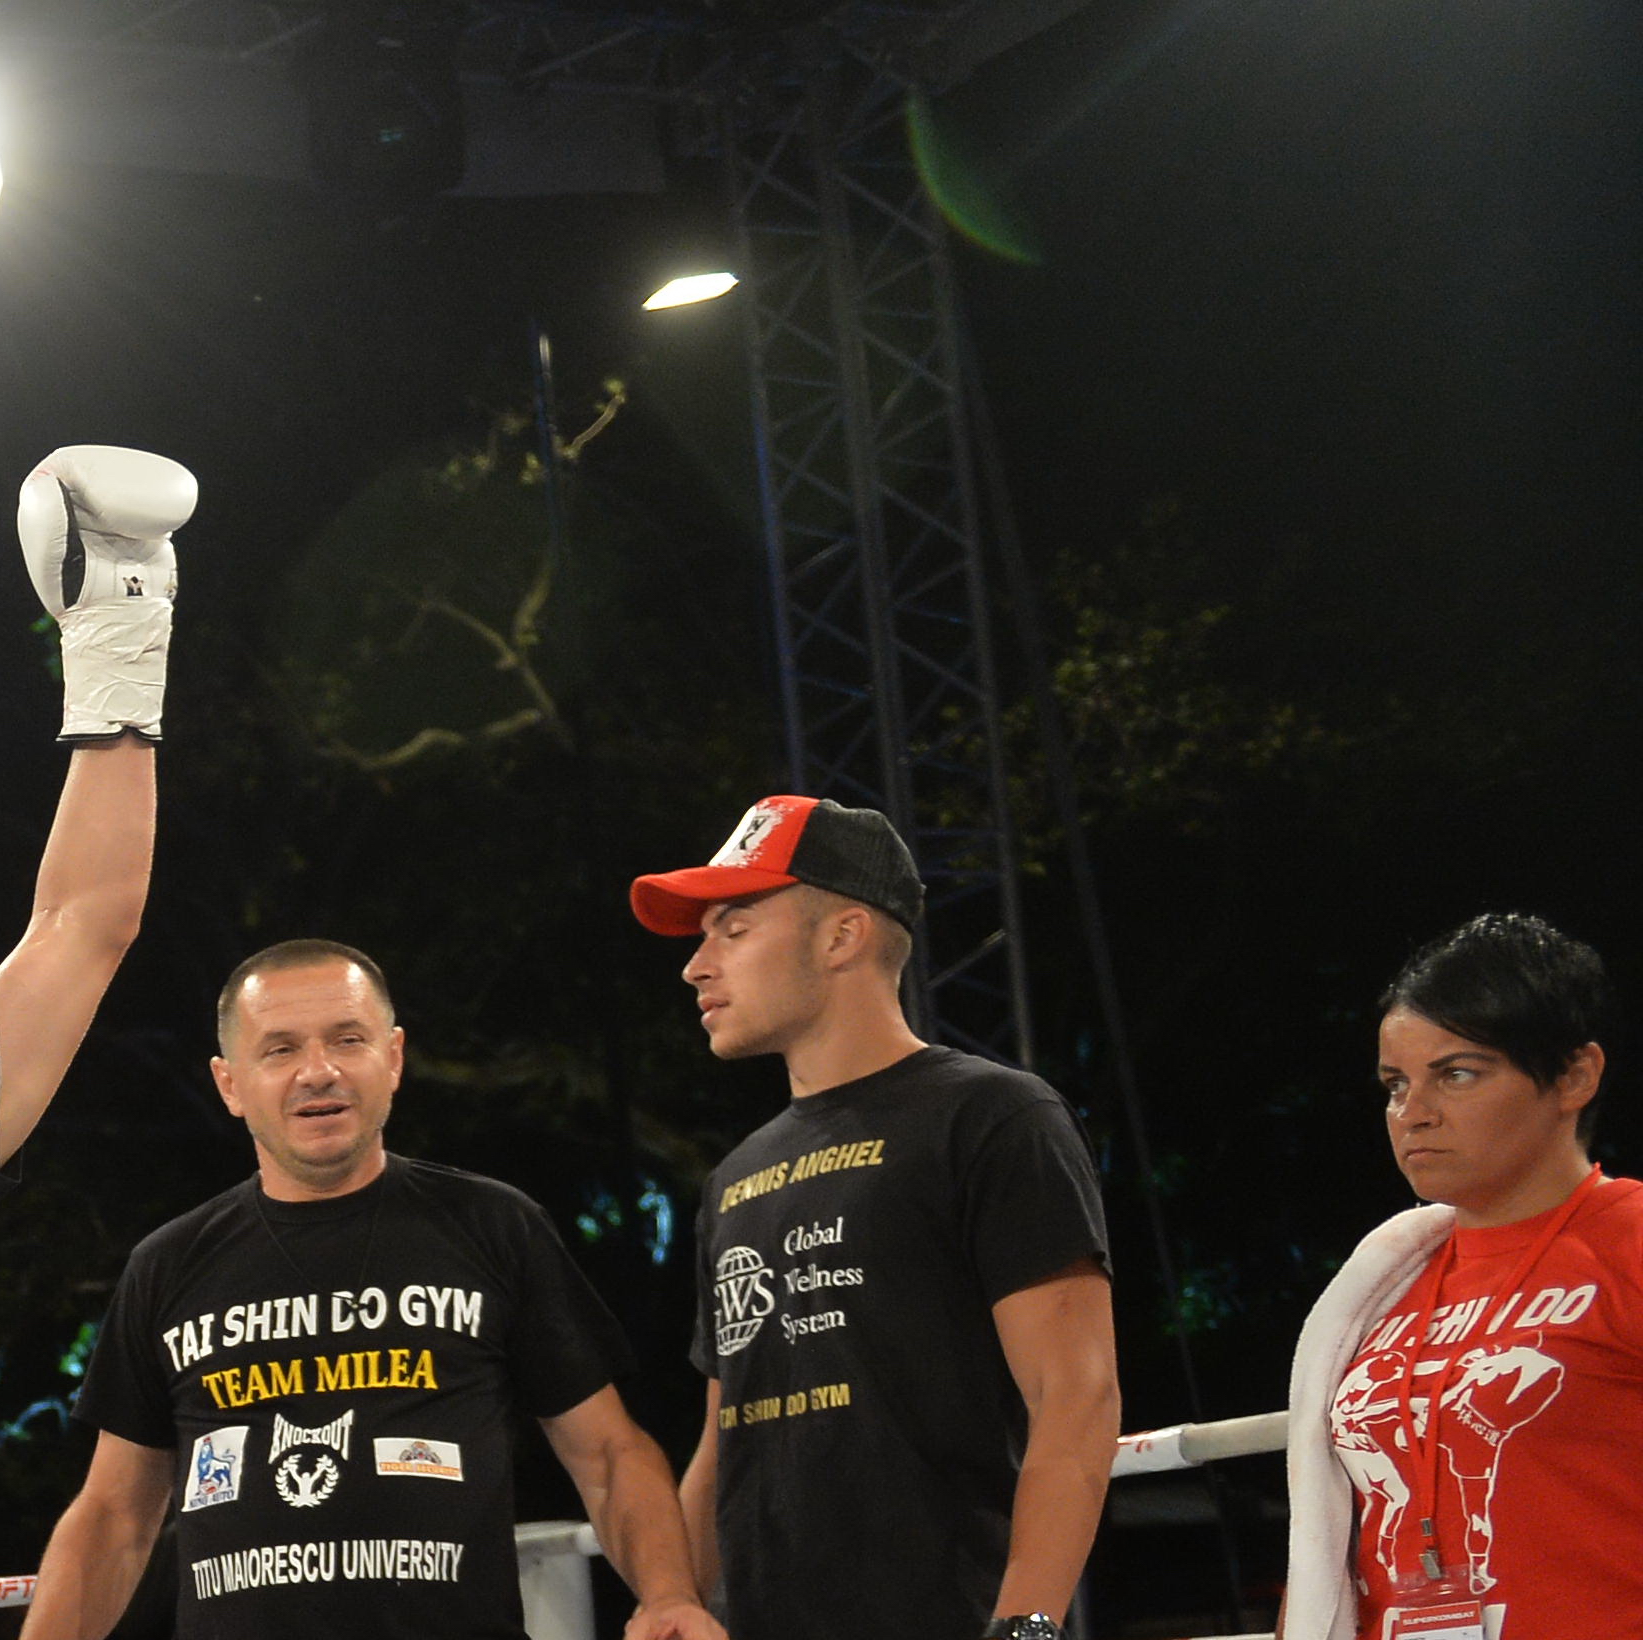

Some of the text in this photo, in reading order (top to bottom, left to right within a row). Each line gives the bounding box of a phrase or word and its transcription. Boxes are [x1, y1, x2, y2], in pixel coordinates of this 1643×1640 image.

[788, 1139, 885, 1184] ANGHEL
[163, 1284, 482, 1372] TAI SHIN DO GYM
[781, 1309, 847, 1346] System
[1513, 1284, 1598, 1328] DO
[202, 1348, 438, 1409] TEAM MILEA
[268, 1408, 354, 1464] KNOCKOUT
[192, 1540, 464, 1600] TITU MAIORESCU UNIVERSITY
